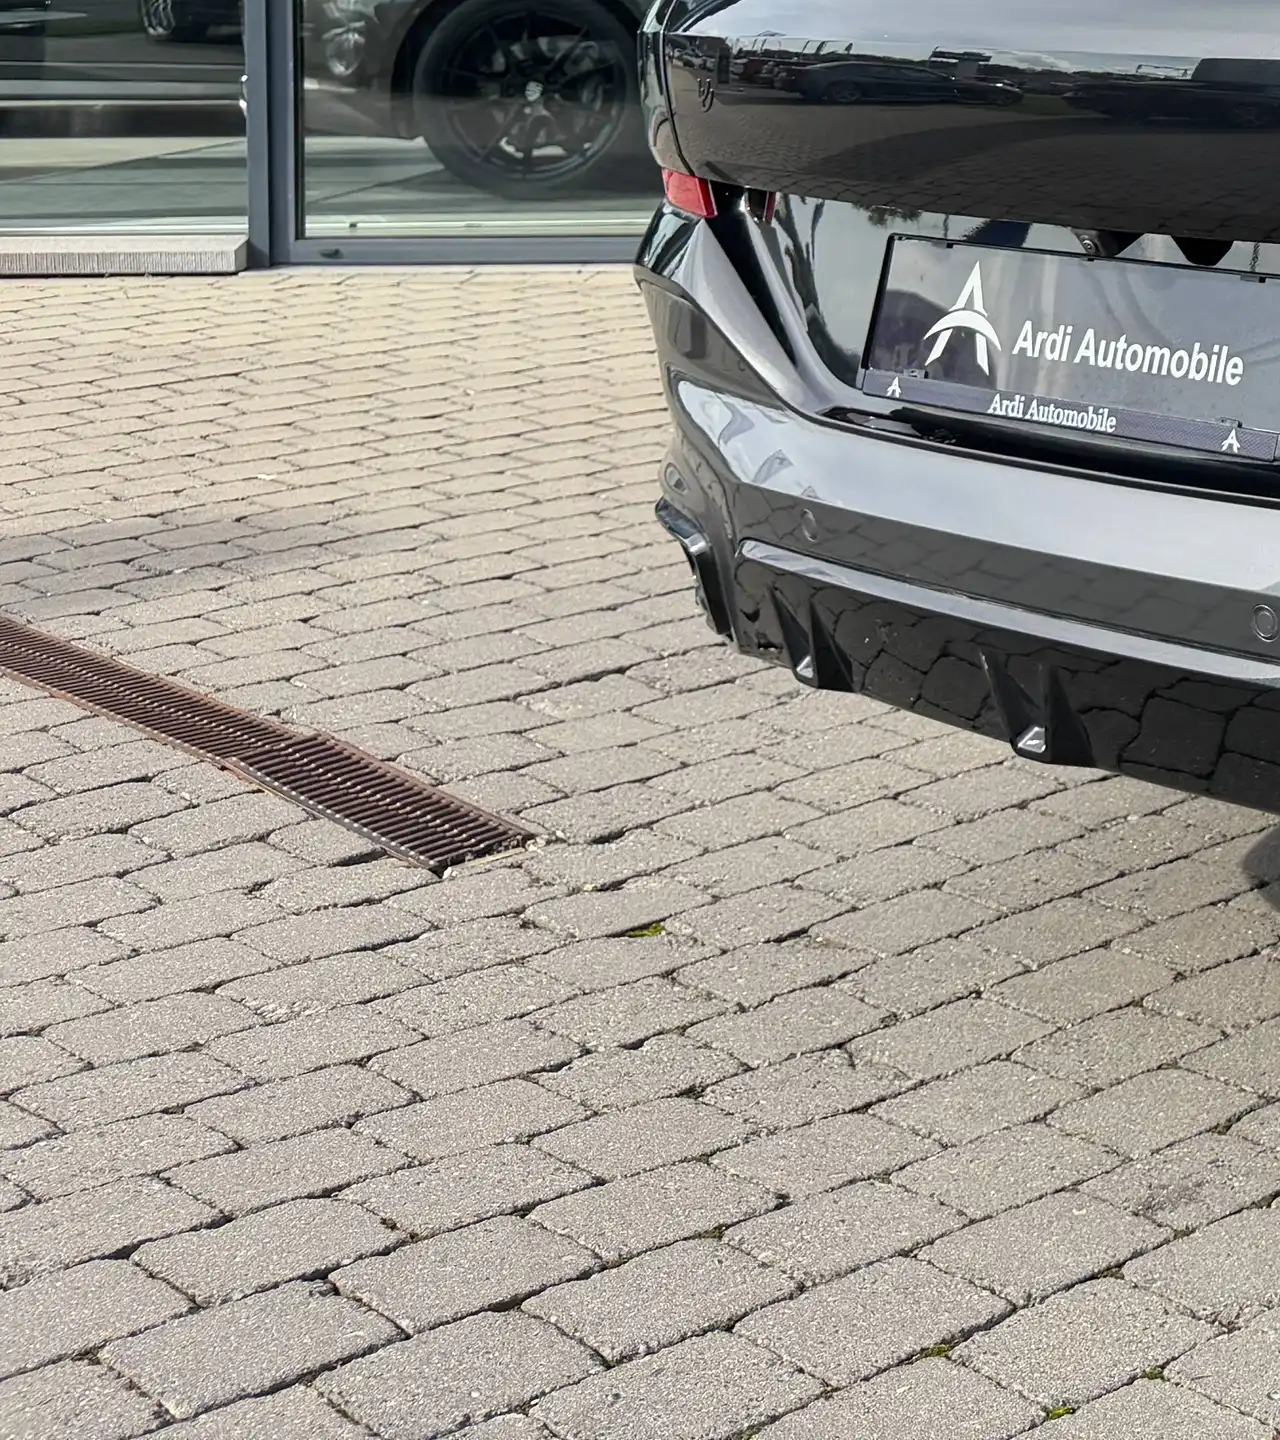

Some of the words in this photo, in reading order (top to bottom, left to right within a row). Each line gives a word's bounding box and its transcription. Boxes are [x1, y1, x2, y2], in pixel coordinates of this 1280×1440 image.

[1012, 320, 1073, 362] Ardi
[1074, 328, 1244, 386] Automobile
[987, 392, 1025, 419] Ardi
[1026, 397, 1117, 434] Automobile
